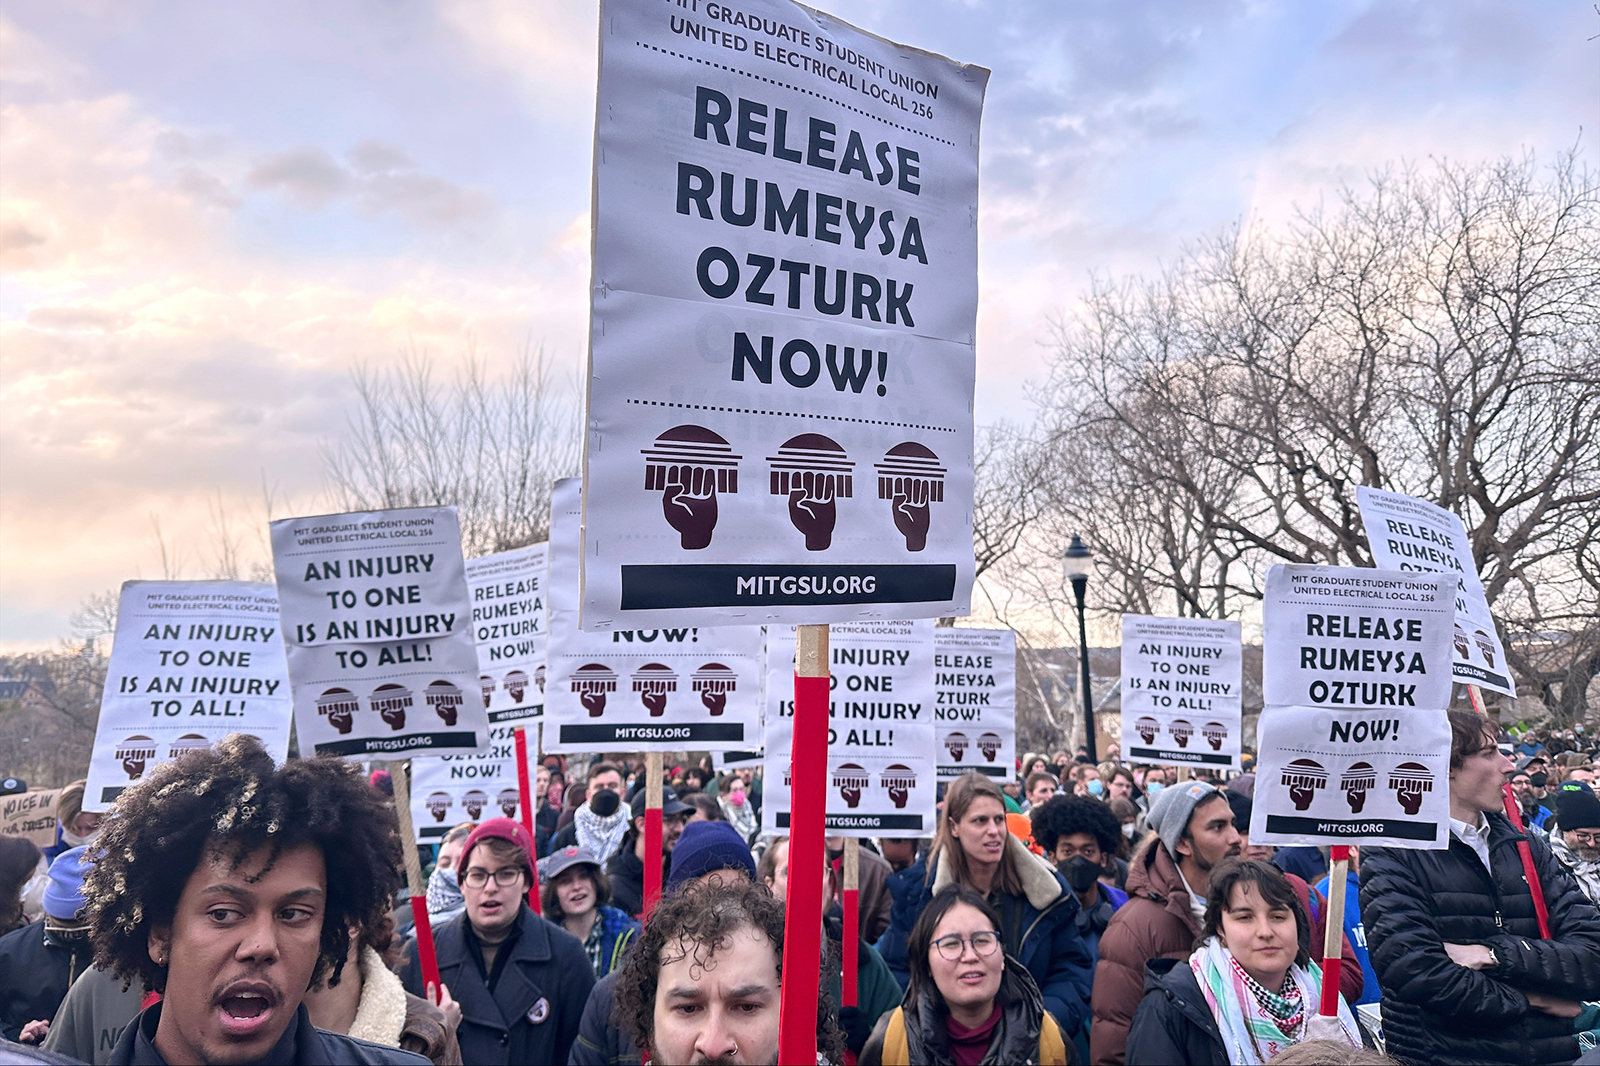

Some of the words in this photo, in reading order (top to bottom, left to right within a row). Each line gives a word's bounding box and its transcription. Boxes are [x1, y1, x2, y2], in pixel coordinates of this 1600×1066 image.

[706, 2, 810, 48] GRADUATE
[815, 36, 884, 78] STUDENT
[888, 69, 938, 100] UNION
[670, 14, 748, 52] UNITED
[754, 40, 858, 90] ELECTRICAL
[862, 78, 908, 112] LOCAL
[912, 100, 934, 120] 256
[693, 85, 921, 196] RELEASE
[676, 161, 929, 265] RUMEYSA
[696, 246, 915, 328] OZTURK
[731, 332, 888, 398] NOW!
[293, 528, 310, 536] MIT
[312, 524, 359, 535] GRADUATE
[361, 520, 402, 531] STUDENT
[404, 518, 434, 528] UNION
[1386, 518, 1454, 550] RELEASE
[298, 536, 333, 546] UNITED
[335, 532, 388, 543] ELECTRICAL
[390, 530, 418, 539] LOCAL
[419, 528, 434, 536] 256
[1387, 538, 1464, 573] RUMEYSA
[304, 560, 342, 582] AN
[348, 554, 434, 578] INJURY
[475, 577, 539, 602] RELEASE
[736, 575, 876, 596] MITGSU.ORG
[1292, 575, 1308, 583] MIT
[1310, 576, 1360, 586] GRADUATE
[1362, 580, 1402, 590] STUDENT
[1404, 582, 1438, 591] UNION
[212, 594, 252, 603] STUDENT
[326, 590, 357, 609] TO
[365, 585, 422, 608] ONE
[1294, 586, 1330, 596] UNITED
[1333, 588, 1384, 599] ELECTRICAL
[1386, 592, 1418, 601] LOCAL
[1420, 594, 1434, 602] 256
[148, 602, 182, 610] UNITED
[235, 604, 264, 612] LOCAL
[473, 597, 543, 622] RUMEYSA
[143, 624, 182, 640] AN
[188, 624, 276, 642] INJURY
[297, 622, 316, 643] IS
[326, 620, 359, 640] AN
[366, 613, 456, 638] INJURY
[478, 618, 539, 640] OZTURK
[1306, 613, 1422, 642] RELEASE
[159, 650, 190, 666] TO
[198, 650, 252, 668] ONE
[336, 650, 368, 668] TO
[378, 644, 432, 666] ALL!
[490, 640, 535, 660] NOW!
[834, 648, 910, 667] INJURY
[1138, 644, 1162, 656] AN
[1167, 645, 1222, 659] INJURY
[935, 654, 993, 668] ELEASE
[1151, 662, 1171, 673] TO
[1176, 664, 1210, 676] ONE
[1300, 646, 1426, 674] RUMEYSA
[119, 676, 138, 693] IS
[146, 676, 184, 693] AN
[190, 676, 280, 696] INJURY
[846, 675, 892, 692] ONE
[1130, 678, 1141, 689] IS
[1147, 679, 1170, 691] AN
[1176, 680, 1231, 695] INJURY
[936, 691, 990, 705] ZTURK
[1309, 680, 1416, 706] OZTURK
[150, 700, 182, 717] TO
[190, 700, 246, 717] ALL!
[779, 700, 794, 717] IS
[844, 702, 922, 721] INJURY
[1152, 695, 1172, 707] TO
[1178, 698, 1212, 710] ALL!
[935, 707, 981, 721] NOW!
[615, 727, 691, 739] MITGSU.ORG
[845, 729, 894, 746] ALL!
[1329, 719, 1400, 743] NOW!
[366, 736, 432, 750] MITGSU.ORG
[451, 764, 501, 779] NOW!
[39, 794, 53, 808] IN
[22, 816, 55, 832] STREETS
[826, 817, 880, 827] ITGSU.ORG
[1318, 822, 1384, 834] MITGSU.ORG
